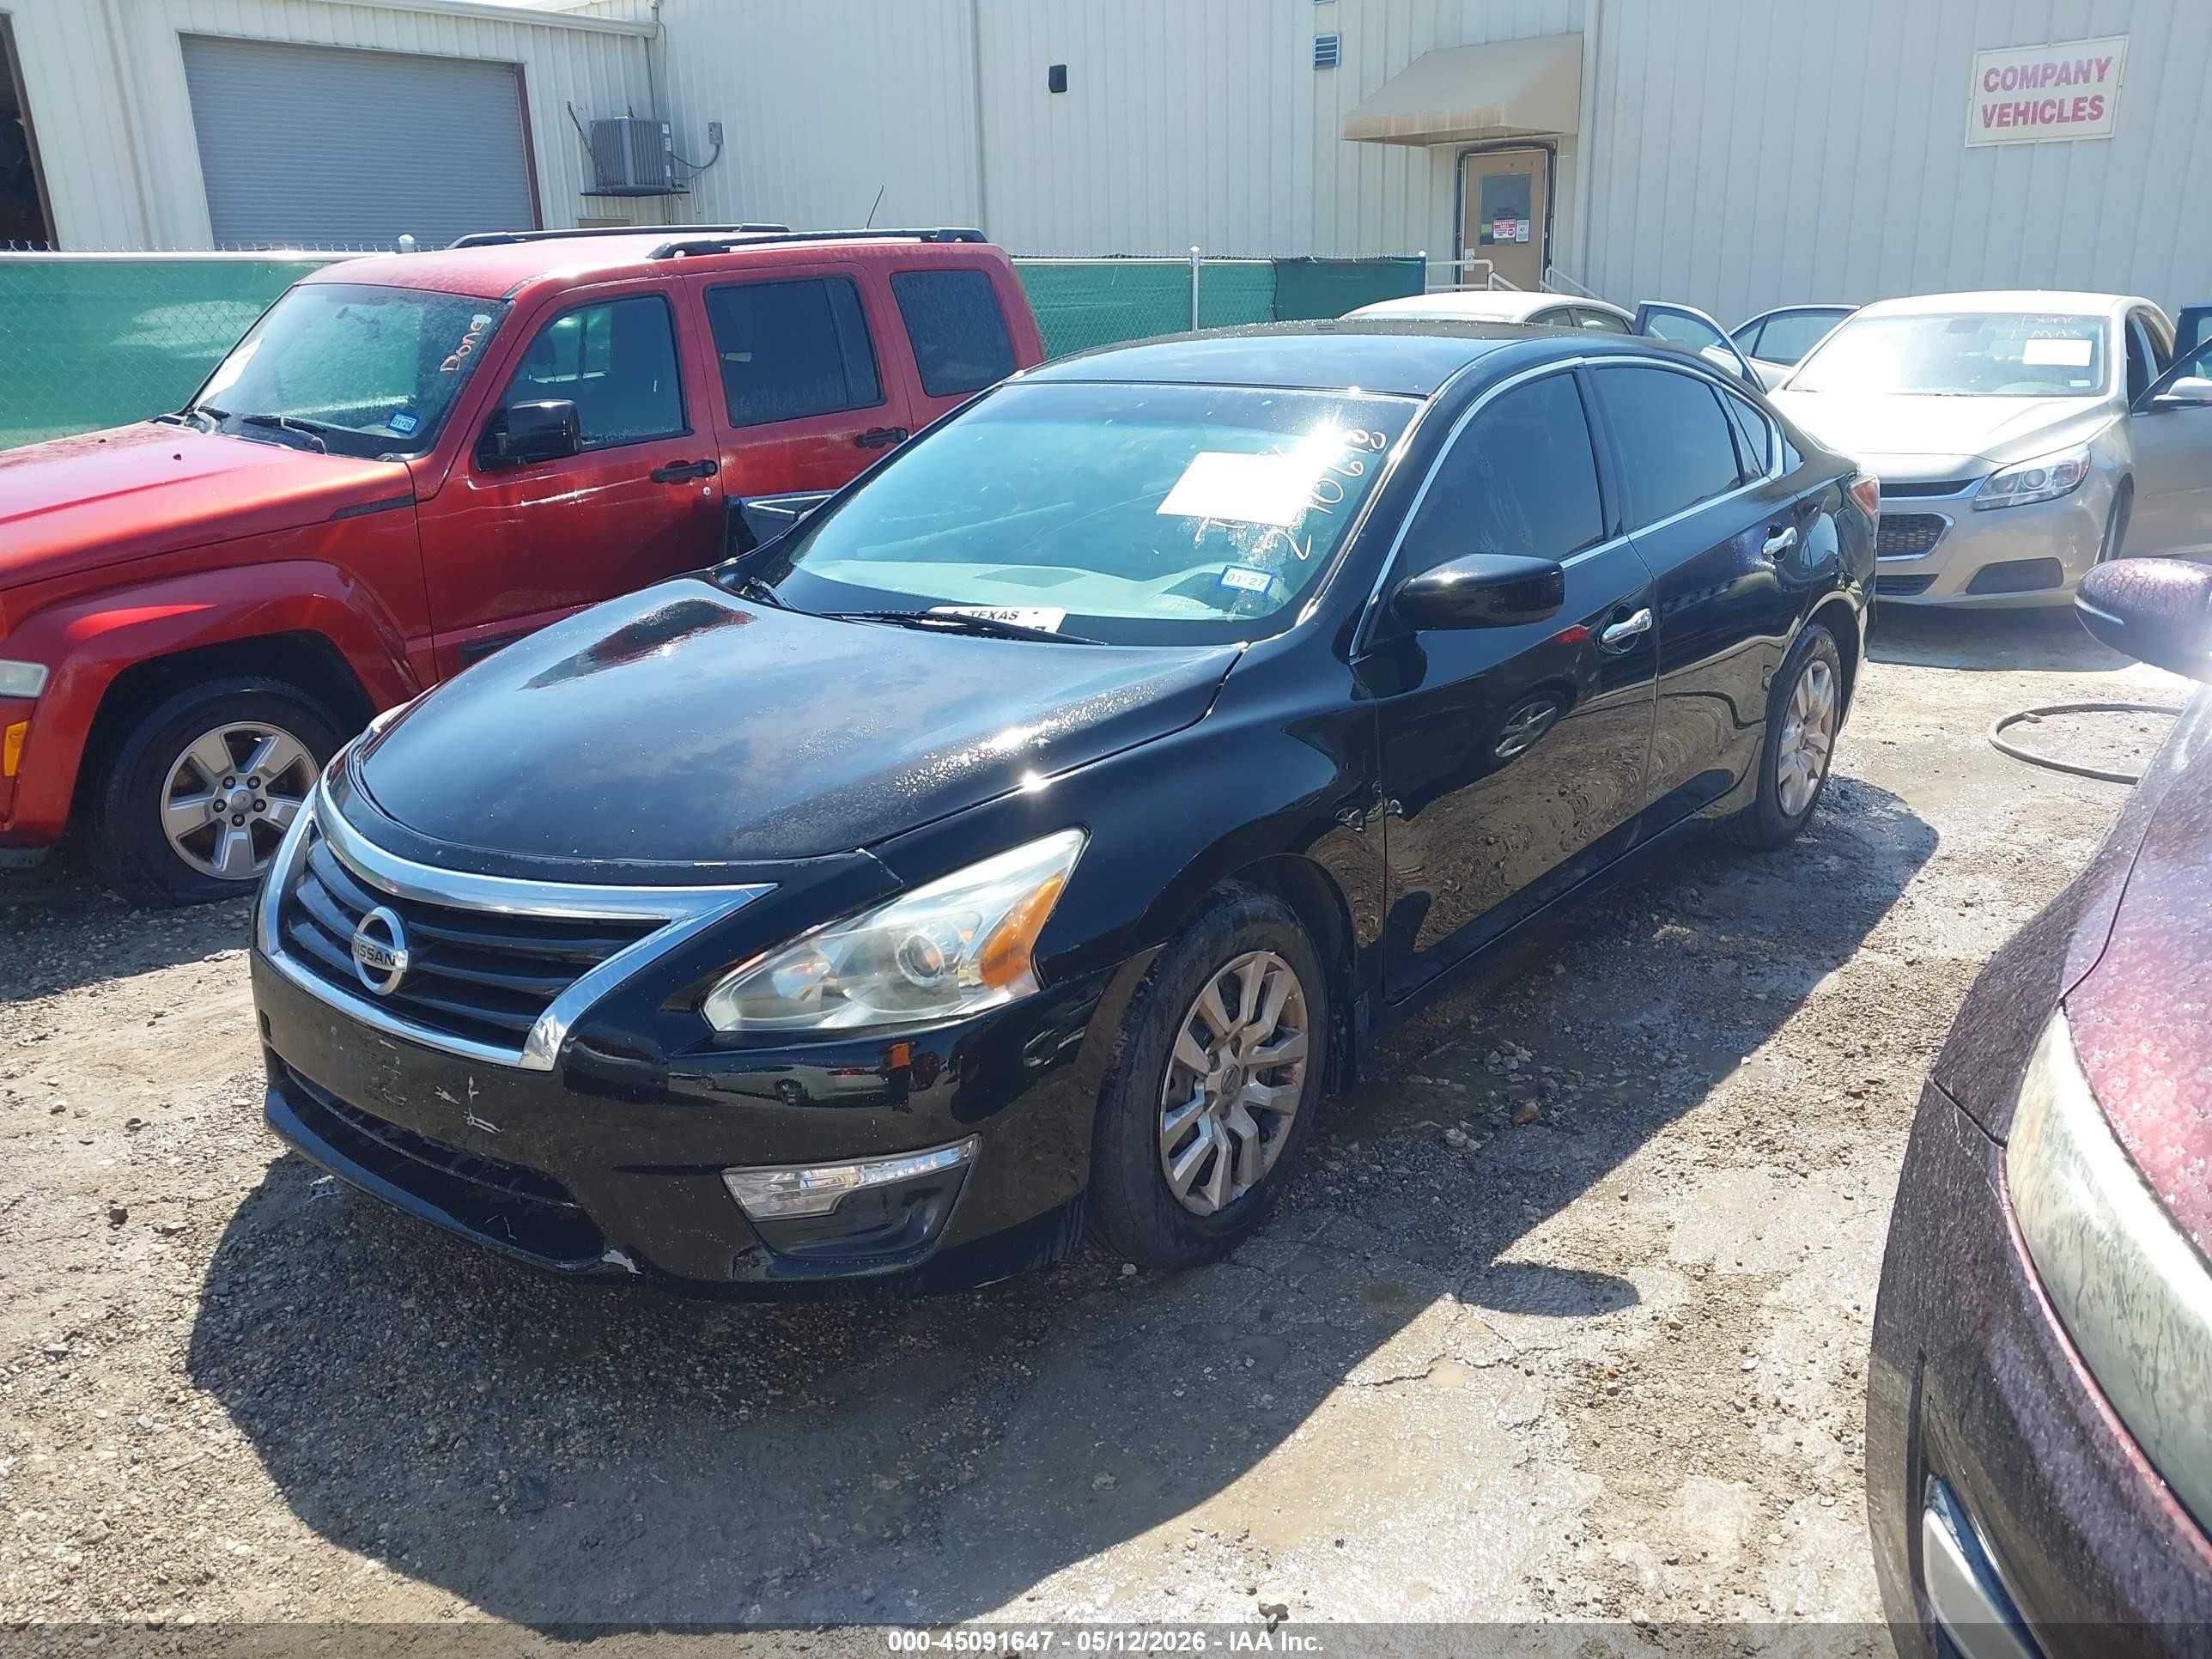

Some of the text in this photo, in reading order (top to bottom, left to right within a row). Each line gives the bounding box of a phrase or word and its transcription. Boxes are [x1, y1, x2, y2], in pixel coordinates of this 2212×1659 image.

[1984, 56, 2113, 93] COMPANY
[1982, 94, 2106, 128] VEHICLES
[969, 610, 1020, 621] TEXAS
[352, 939, 397, 966] NISSAN
